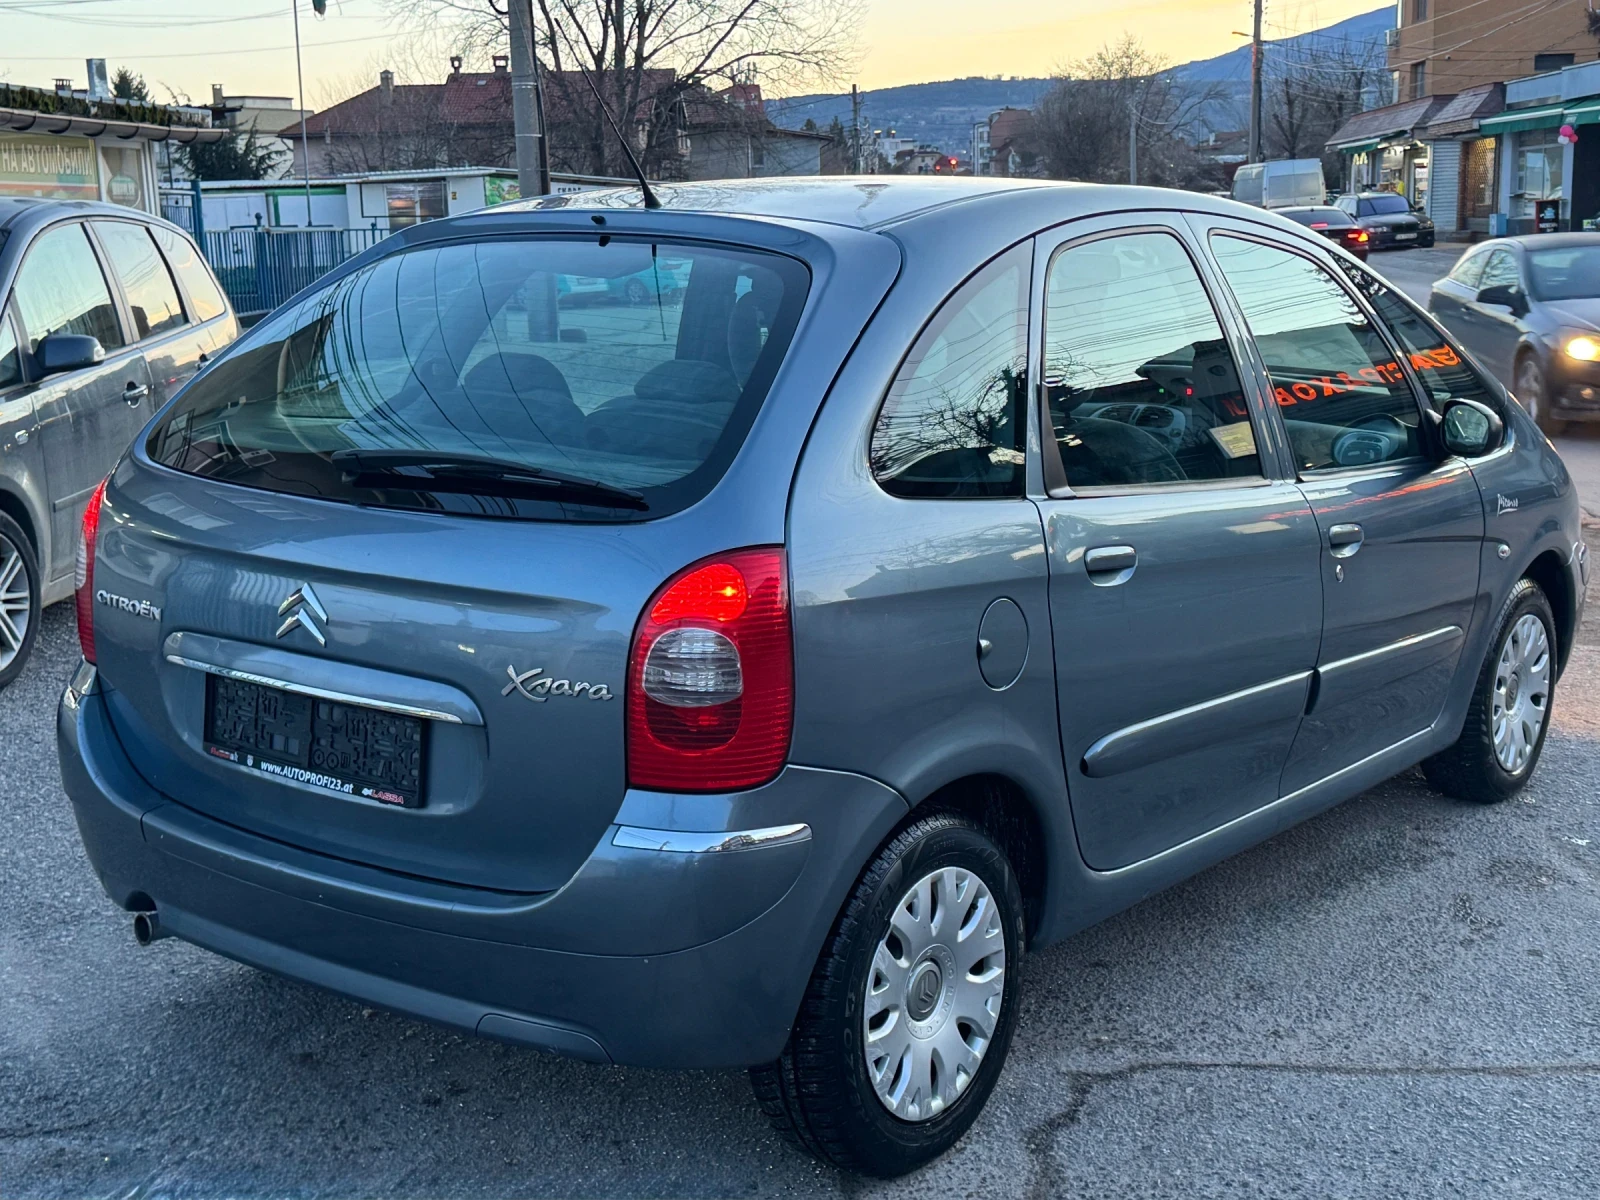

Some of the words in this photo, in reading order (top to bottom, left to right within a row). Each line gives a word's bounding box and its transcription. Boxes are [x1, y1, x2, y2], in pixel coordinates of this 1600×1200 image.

[1, 142, 19, 172] НА
[96, 589, 162, 622] CITROËN
[500, 664, 613, 702] Xsara
[371, 789, 404, 805] LASSA
